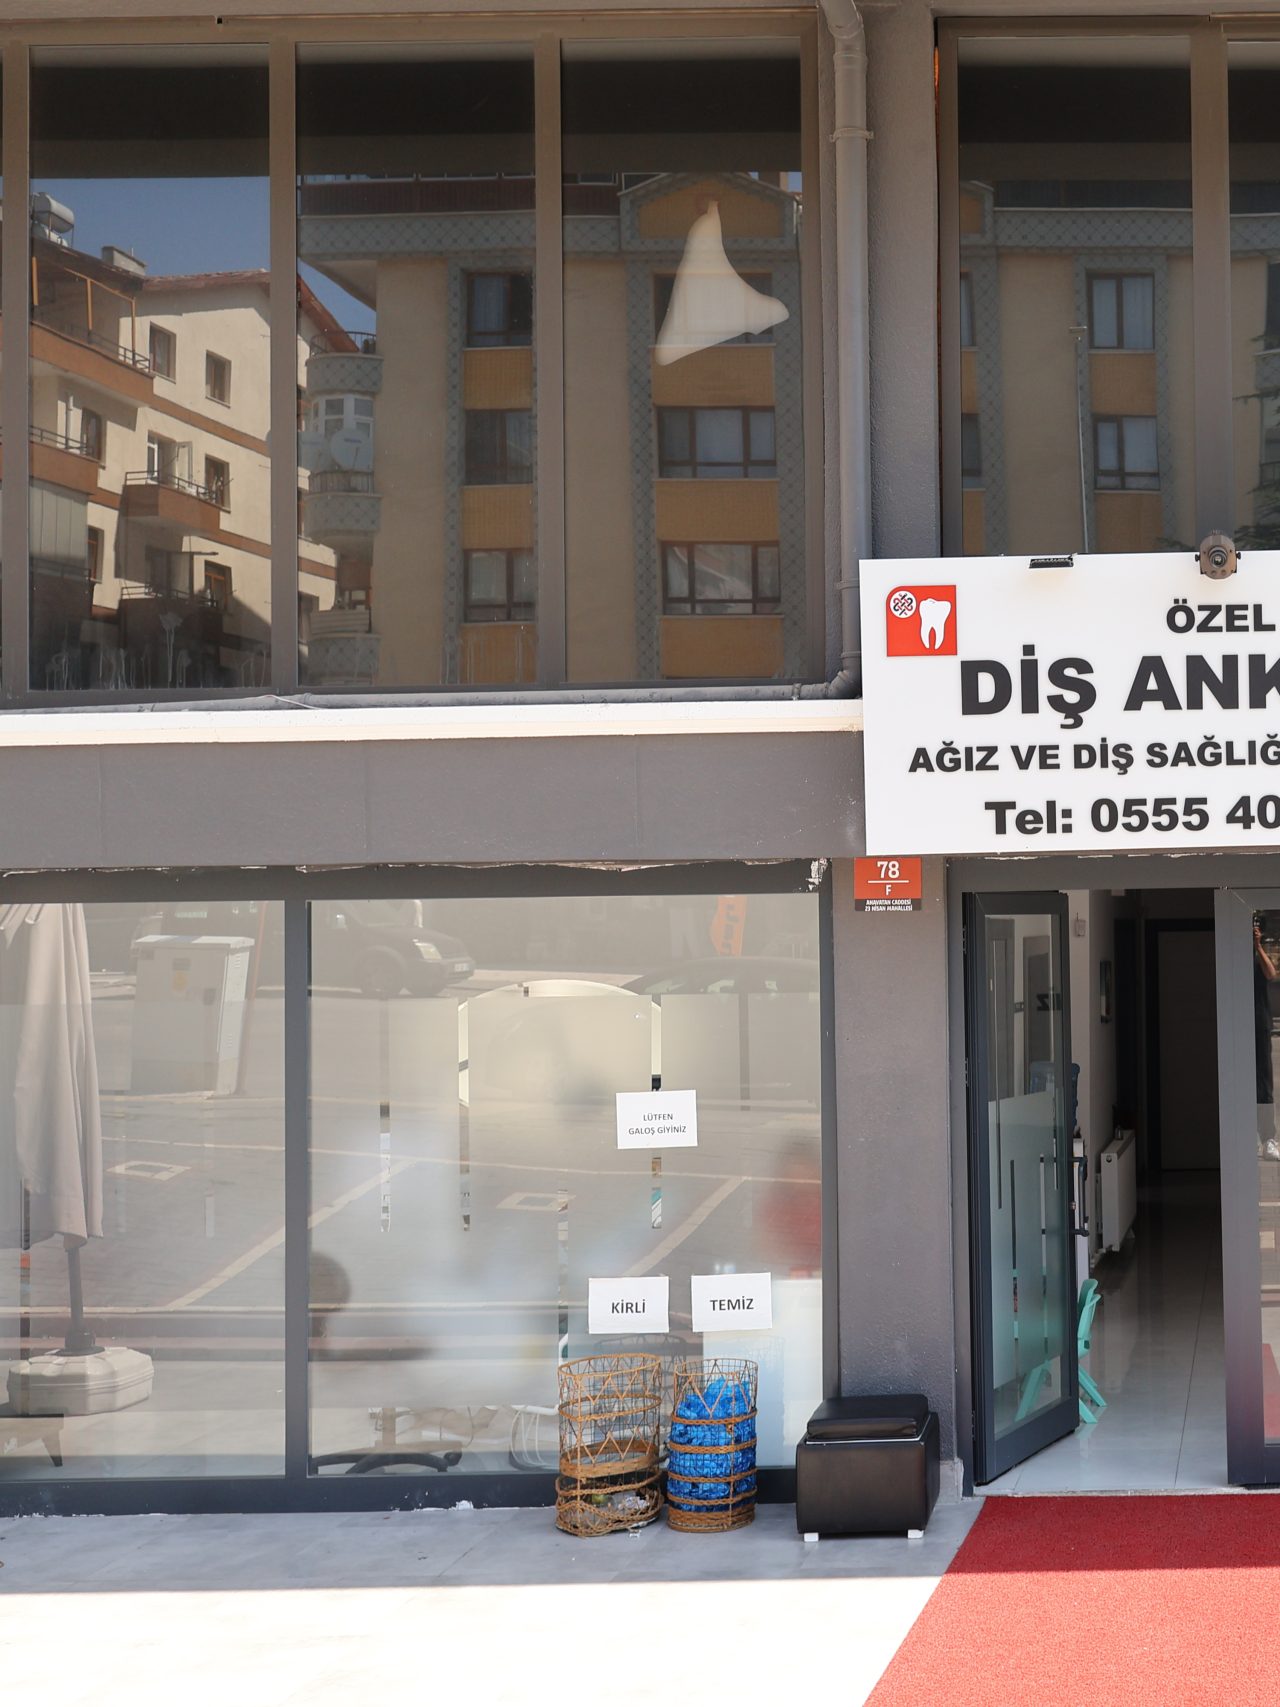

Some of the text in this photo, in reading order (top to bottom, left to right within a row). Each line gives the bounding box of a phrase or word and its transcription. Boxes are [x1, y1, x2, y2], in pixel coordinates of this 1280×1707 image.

[1166, 598, 1276, 634] ÖZEL
[960, 644, 1097, 730] DİŞ
[908, 740, 1000, 773] AĞIZ
[1010, 745, 1061, 771] VE
[1073, 737, 1134, 776] DİŞ
[985, 801, 1073, 835] Tel:
[1090, 797, 1210, 833] 0555
[877, 860, 900, 879] 78
[885, 884, 892, 896] F
[643, 1112, 674, 1122] LÜTFEN
[628, 1124, 687, 1136] GALOŞ GİYİNİZ
[611, 1298, 646, 1314] KİRLİ
[710, 1297, 754, 1312] TEMİZ
